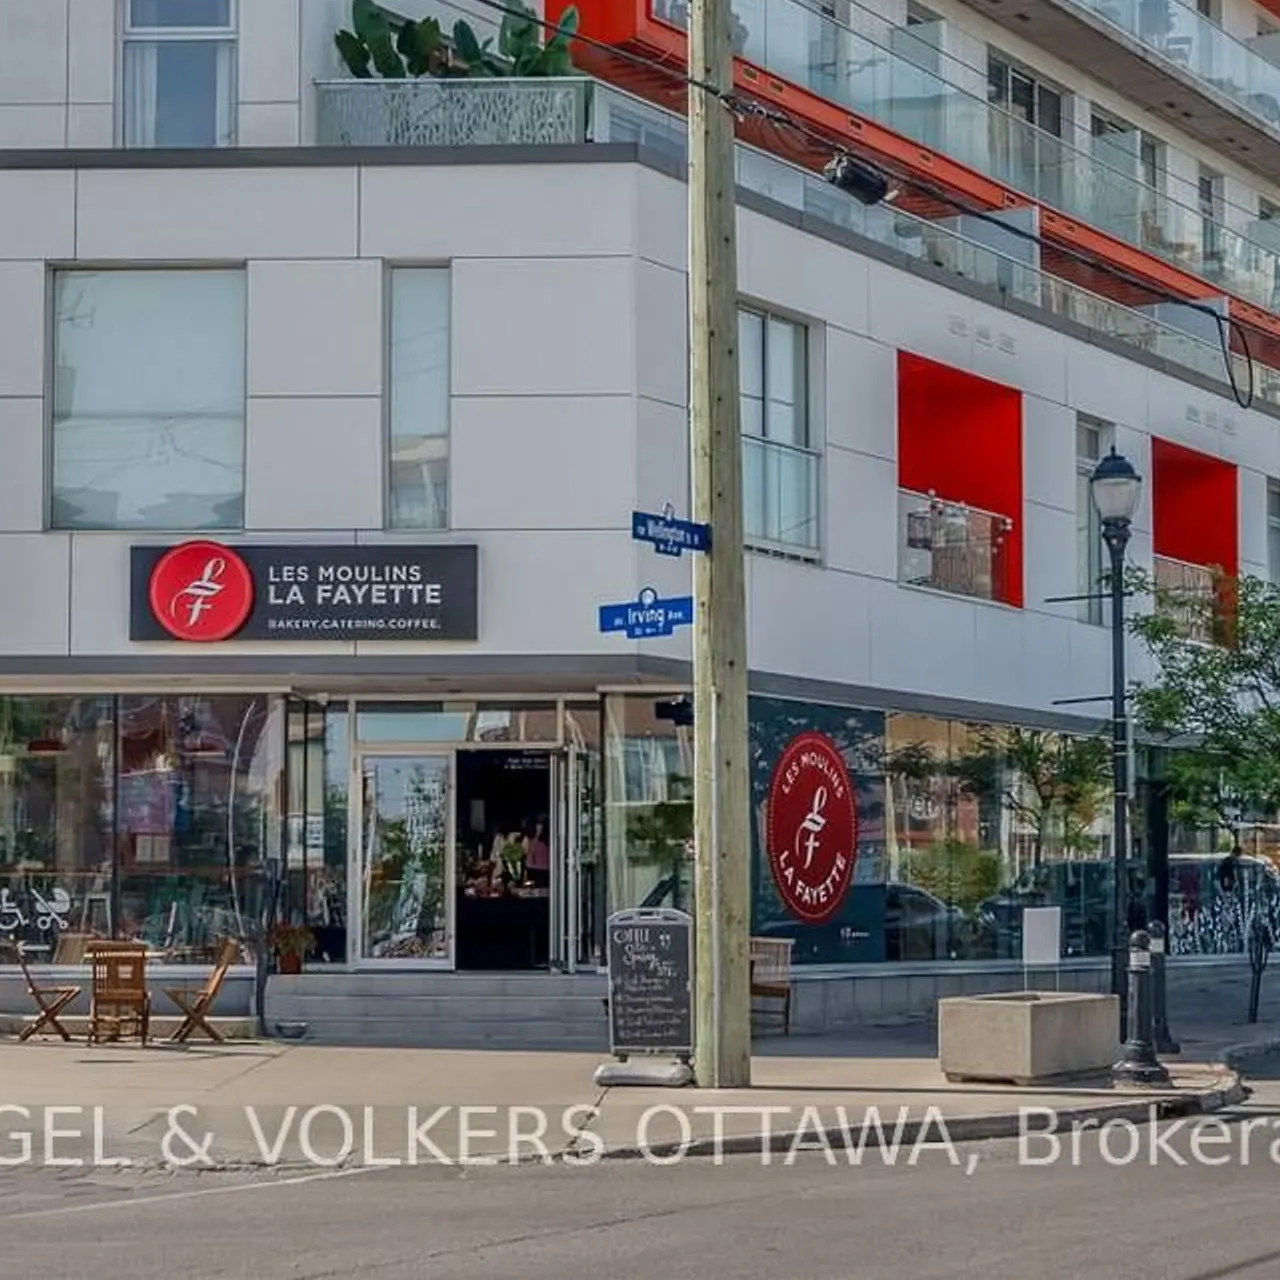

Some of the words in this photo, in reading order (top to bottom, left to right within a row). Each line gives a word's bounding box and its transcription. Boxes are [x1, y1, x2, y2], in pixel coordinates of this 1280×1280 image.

[268, 565, 310, 582] LES
[318, 565, 422, 582] MOULINS
[268, 584, 305, 605] LA
[317, 584, 442, 605] FAYETTE
[628, 608, 664, 627] Irving
[781, 761, 800, 795] LES
[800, 751, 845, 799] MOULINS
[779, 849, 795, 887] LA
[795, 851, 848, 906] FAYETTE
